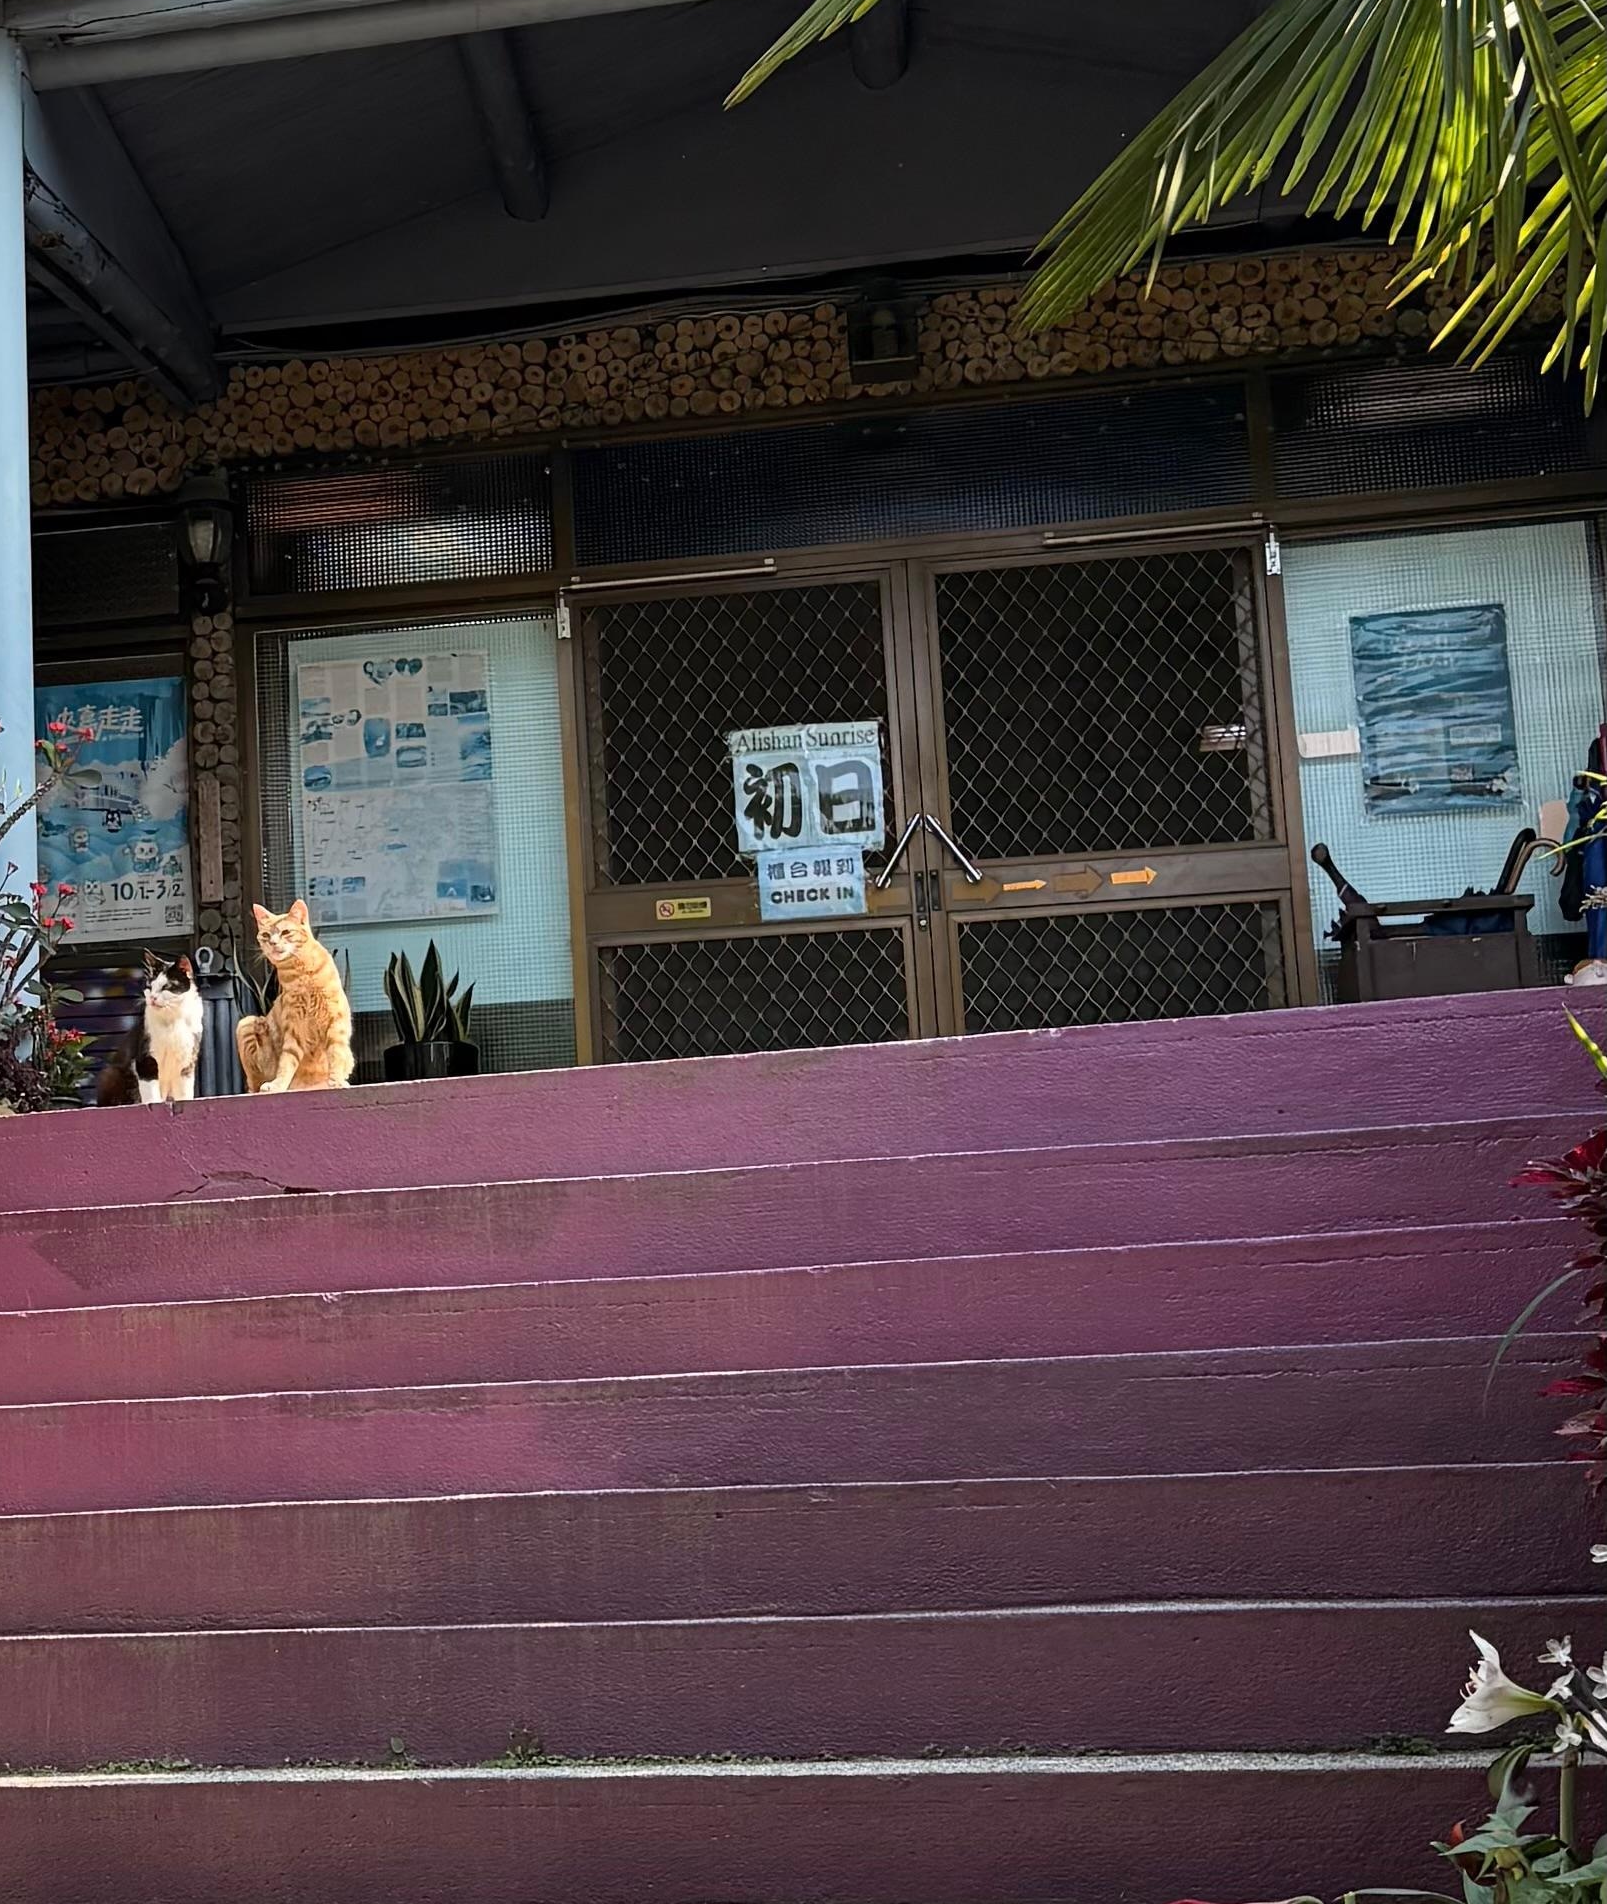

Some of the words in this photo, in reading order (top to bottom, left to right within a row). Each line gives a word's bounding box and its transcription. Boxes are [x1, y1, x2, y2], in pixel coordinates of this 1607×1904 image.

[735, 728, 802, 753] Alishan
[806, 724, 876, 748] Sunrise
[743, 760, 877, 841] 初日
[767, 857, 855, 881] 櫃台報到
[770, 887, 830, 904] CHECK
[837, 885, 855, 900] IN
